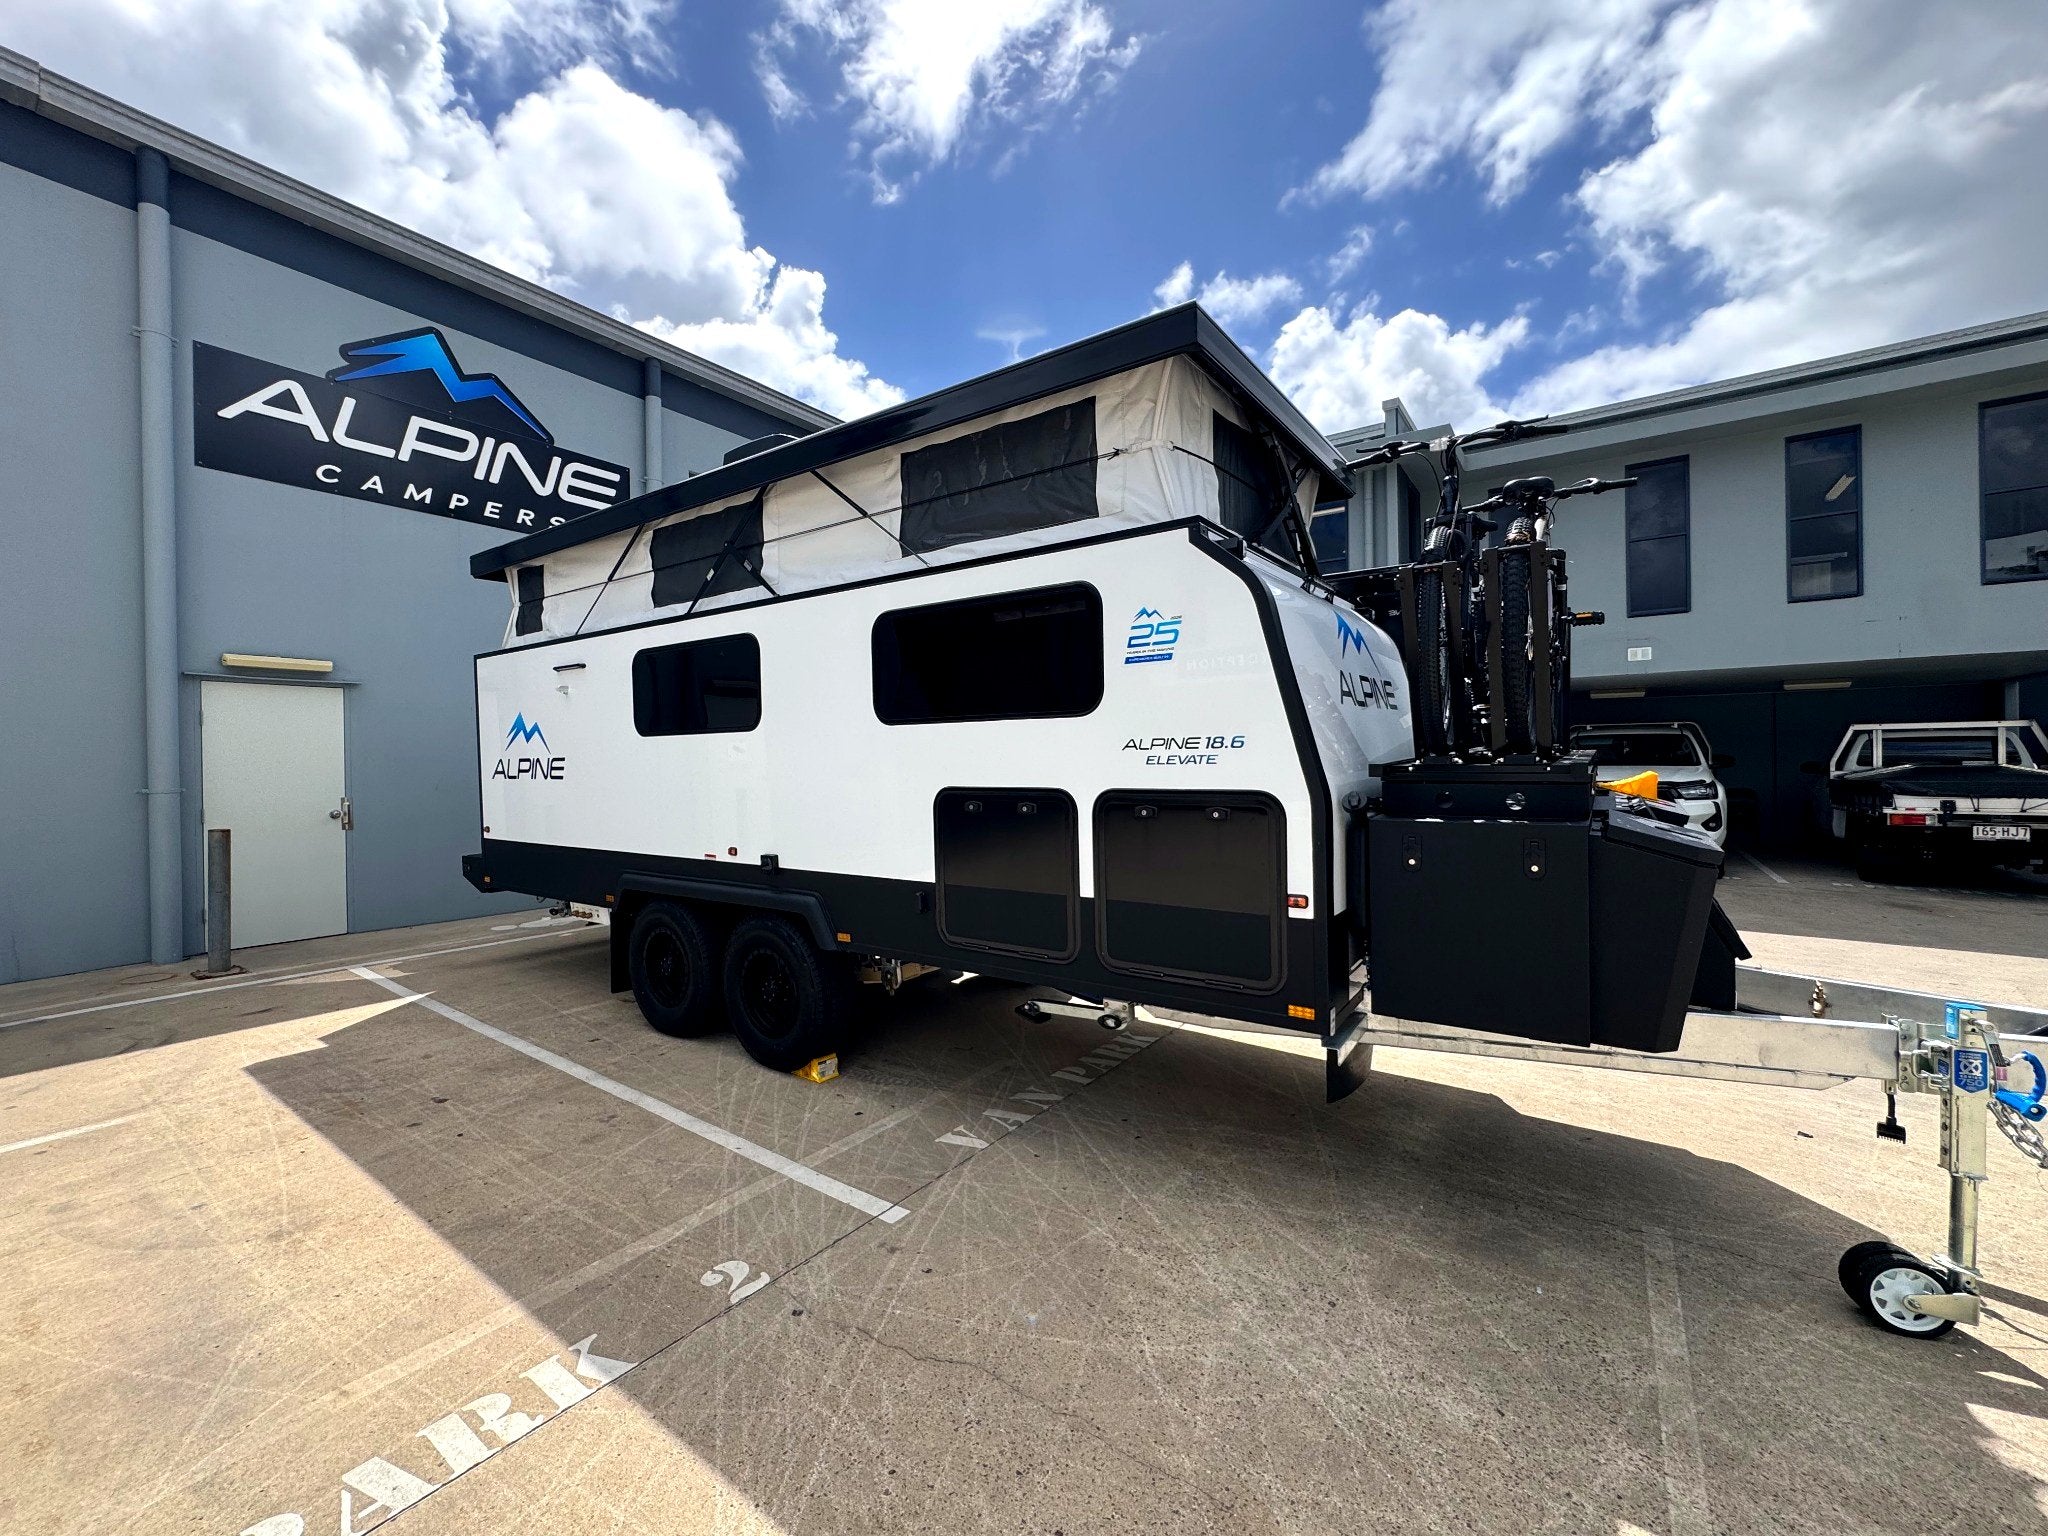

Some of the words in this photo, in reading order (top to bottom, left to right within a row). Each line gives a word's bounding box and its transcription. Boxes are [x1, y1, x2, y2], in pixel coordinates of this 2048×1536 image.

[217, 379, 620, 510] ALPINE
[1126, 620, 1182, 648] 25
[1339, 669, 1398, 711] ALPINE
[1122, 737, 1201, 751] ALPINE
[1205, 735, 1245, 750] 18.6
[1145, 754, 1218, 765] ELEVATE
[491, 757, 566, 780] ALPINE
[934, 1086, 1065, 1150] VAN
[1050, 1031, 1161, 1086] PARK
[700, 1260, 771, 1305] 2
